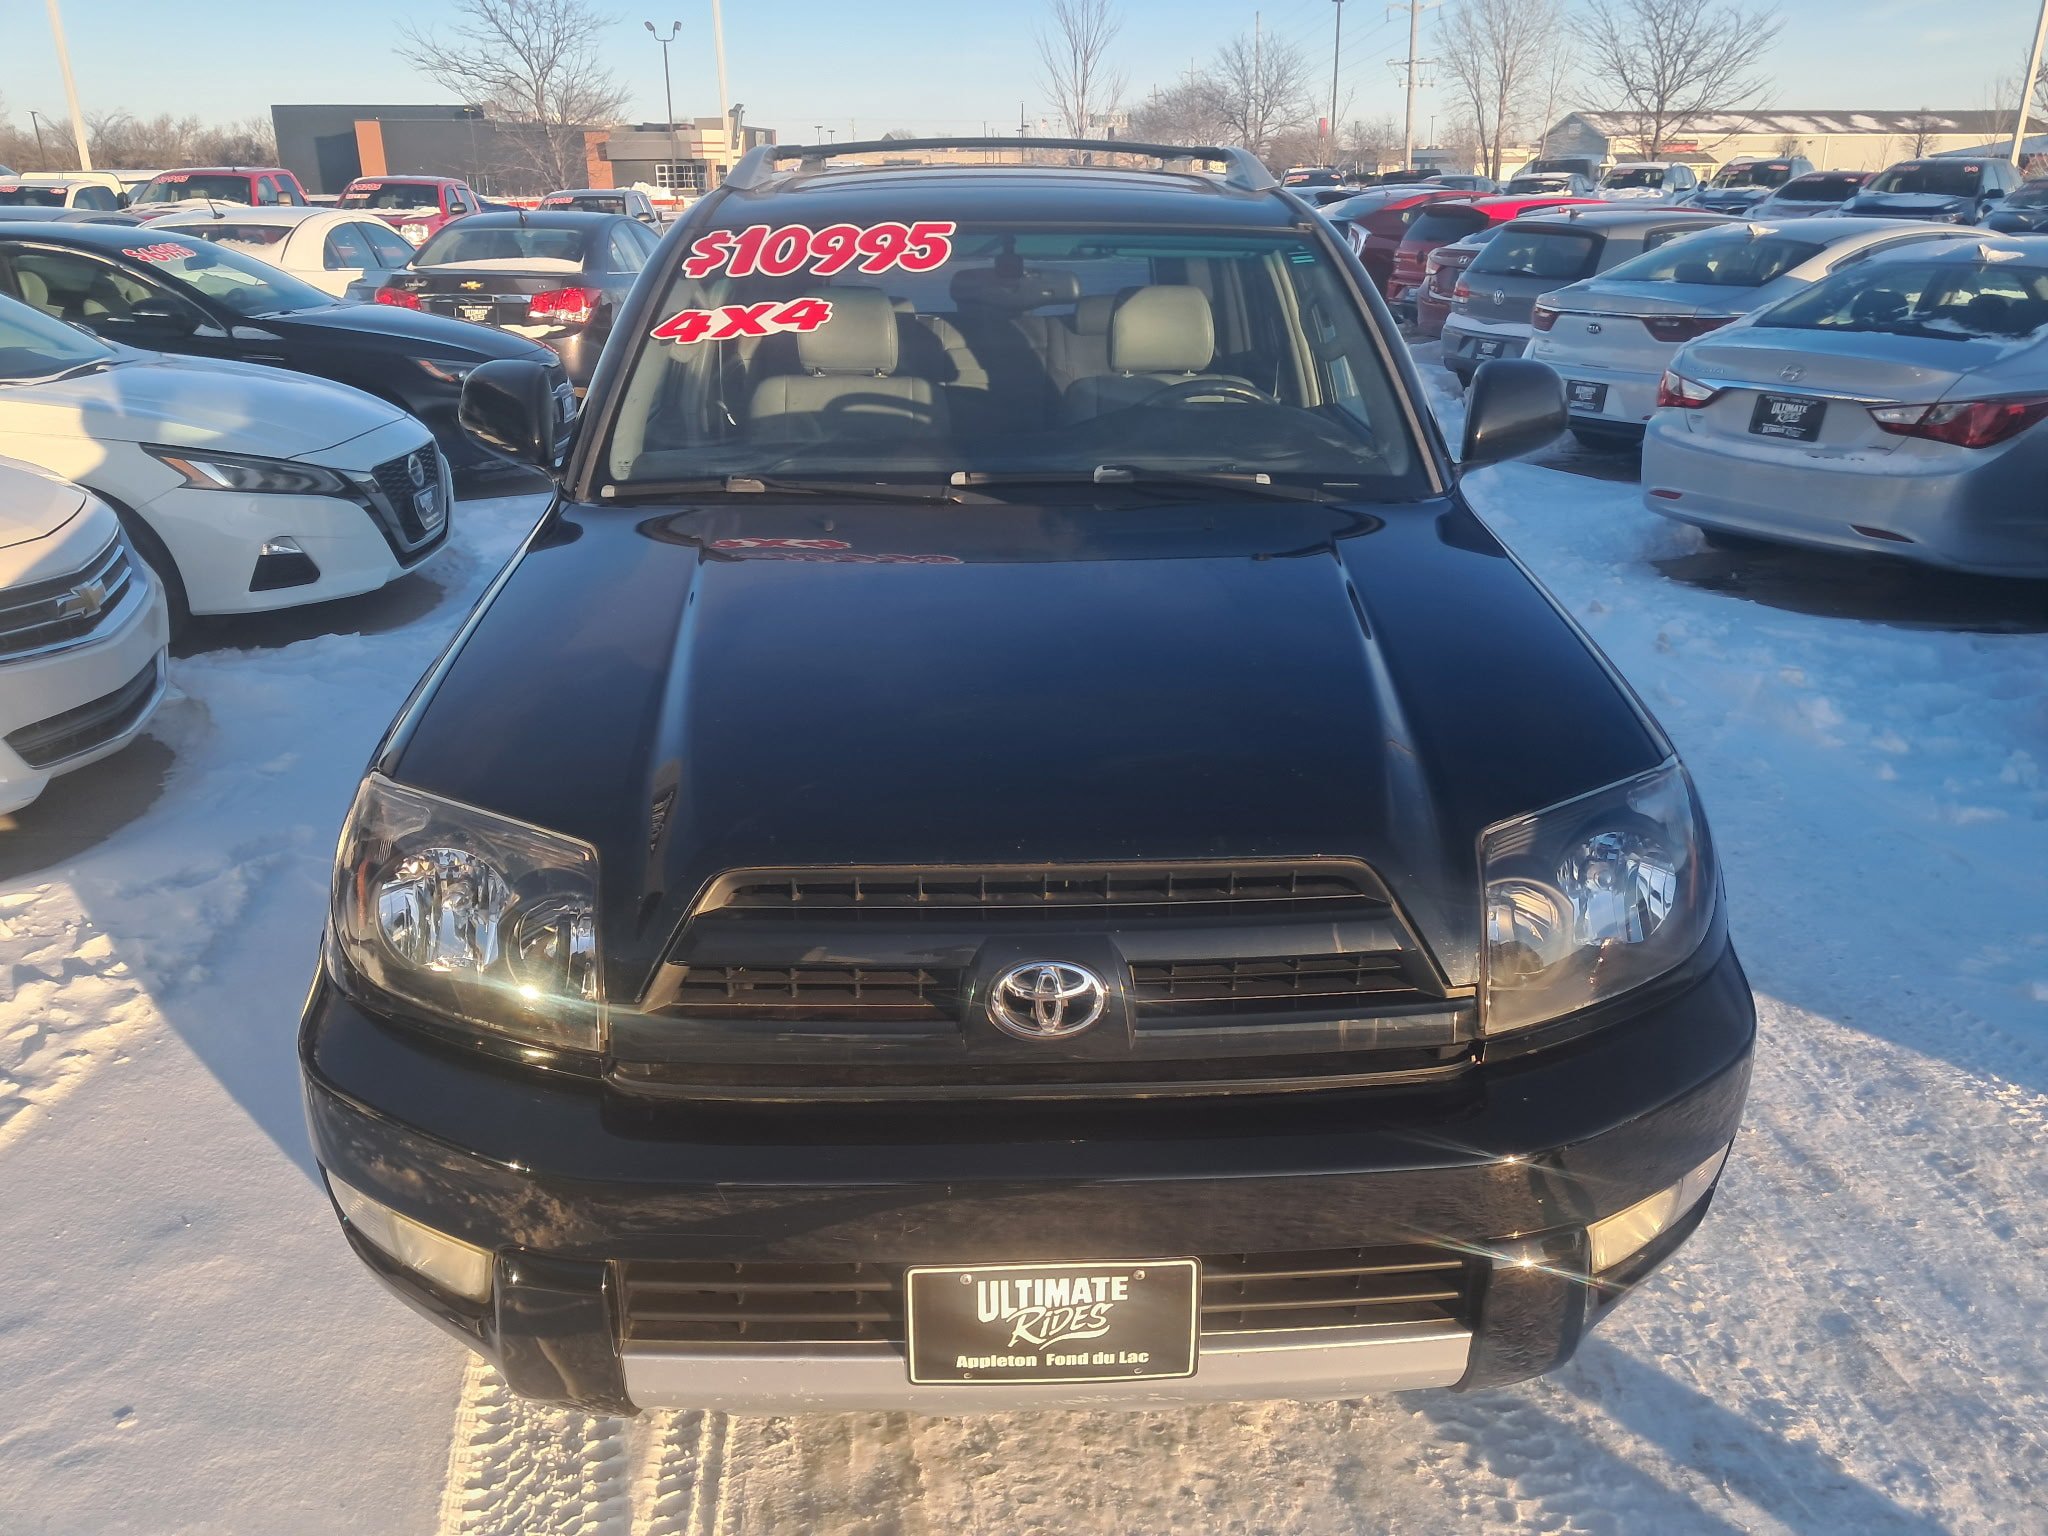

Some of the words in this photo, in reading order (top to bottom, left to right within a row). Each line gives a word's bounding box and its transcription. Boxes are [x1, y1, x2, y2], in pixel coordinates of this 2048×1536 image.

[682, 221, 956, 278] $10995
[650, 297, 833, 344] 4X4
[1771, 402, 1808, 414] ULTIMATE
[977, 1276, 1129, 1323] ULTIMATE
[956, 1354, 1038, 1369] Appleton
[1046, 1353, 1089, 1367] Fond
[1092, 1352, 1115, 1365] du
[1119, 1351, 1150, 1364] Lac
